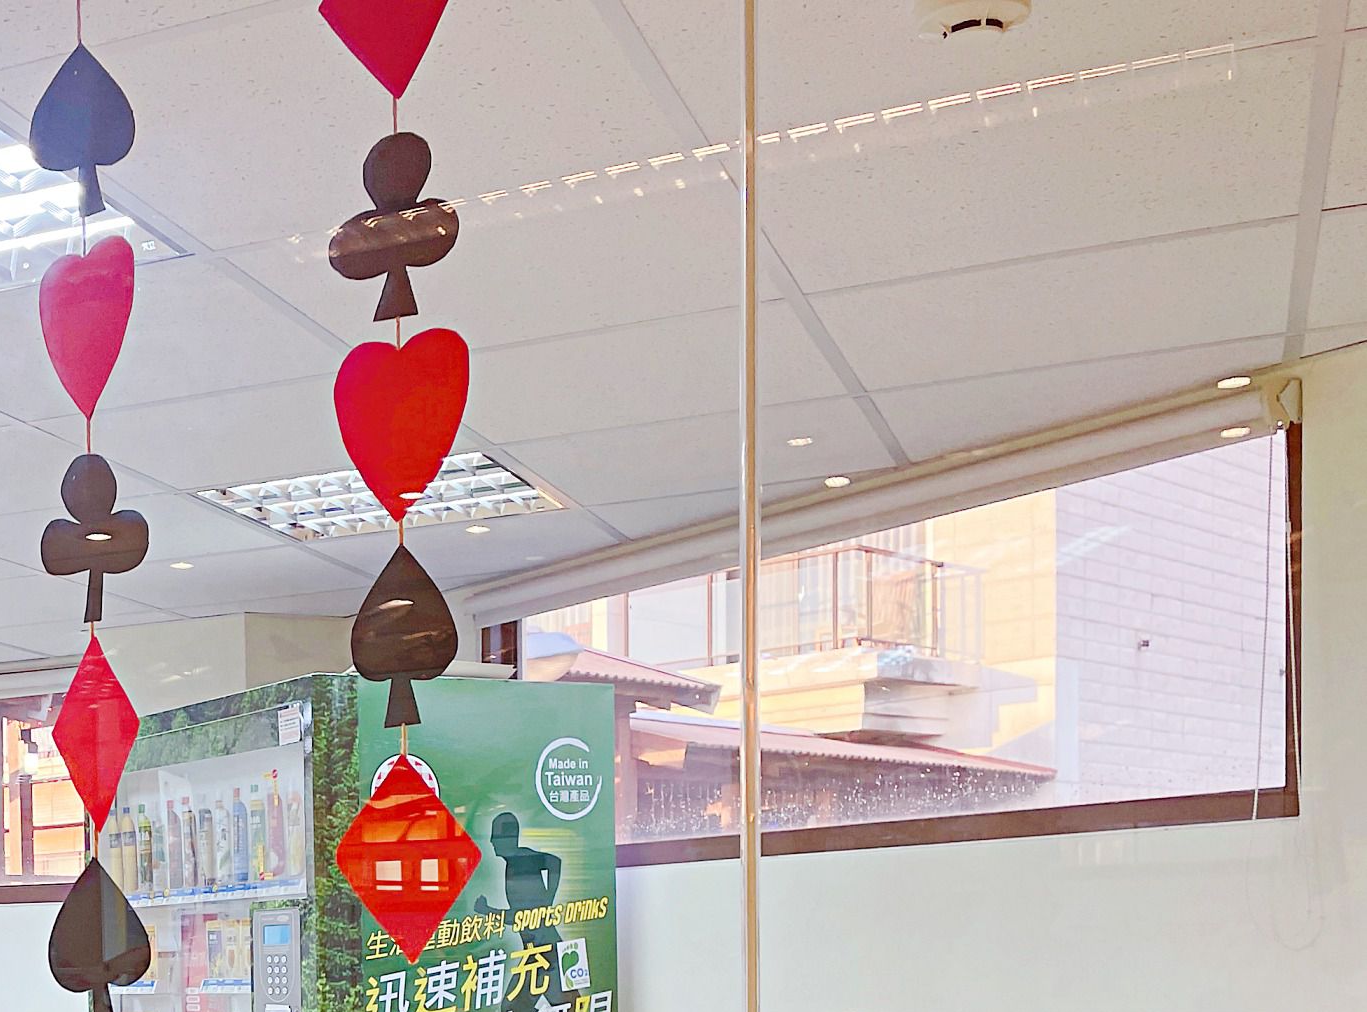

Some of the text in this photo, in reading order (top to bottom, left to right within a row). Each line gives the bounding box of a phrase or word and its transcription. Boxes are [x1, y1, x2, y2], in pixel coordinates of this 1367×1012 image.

[548, 758, 589, 769] Made in
[545, 771, 593, 786] Taiwan
